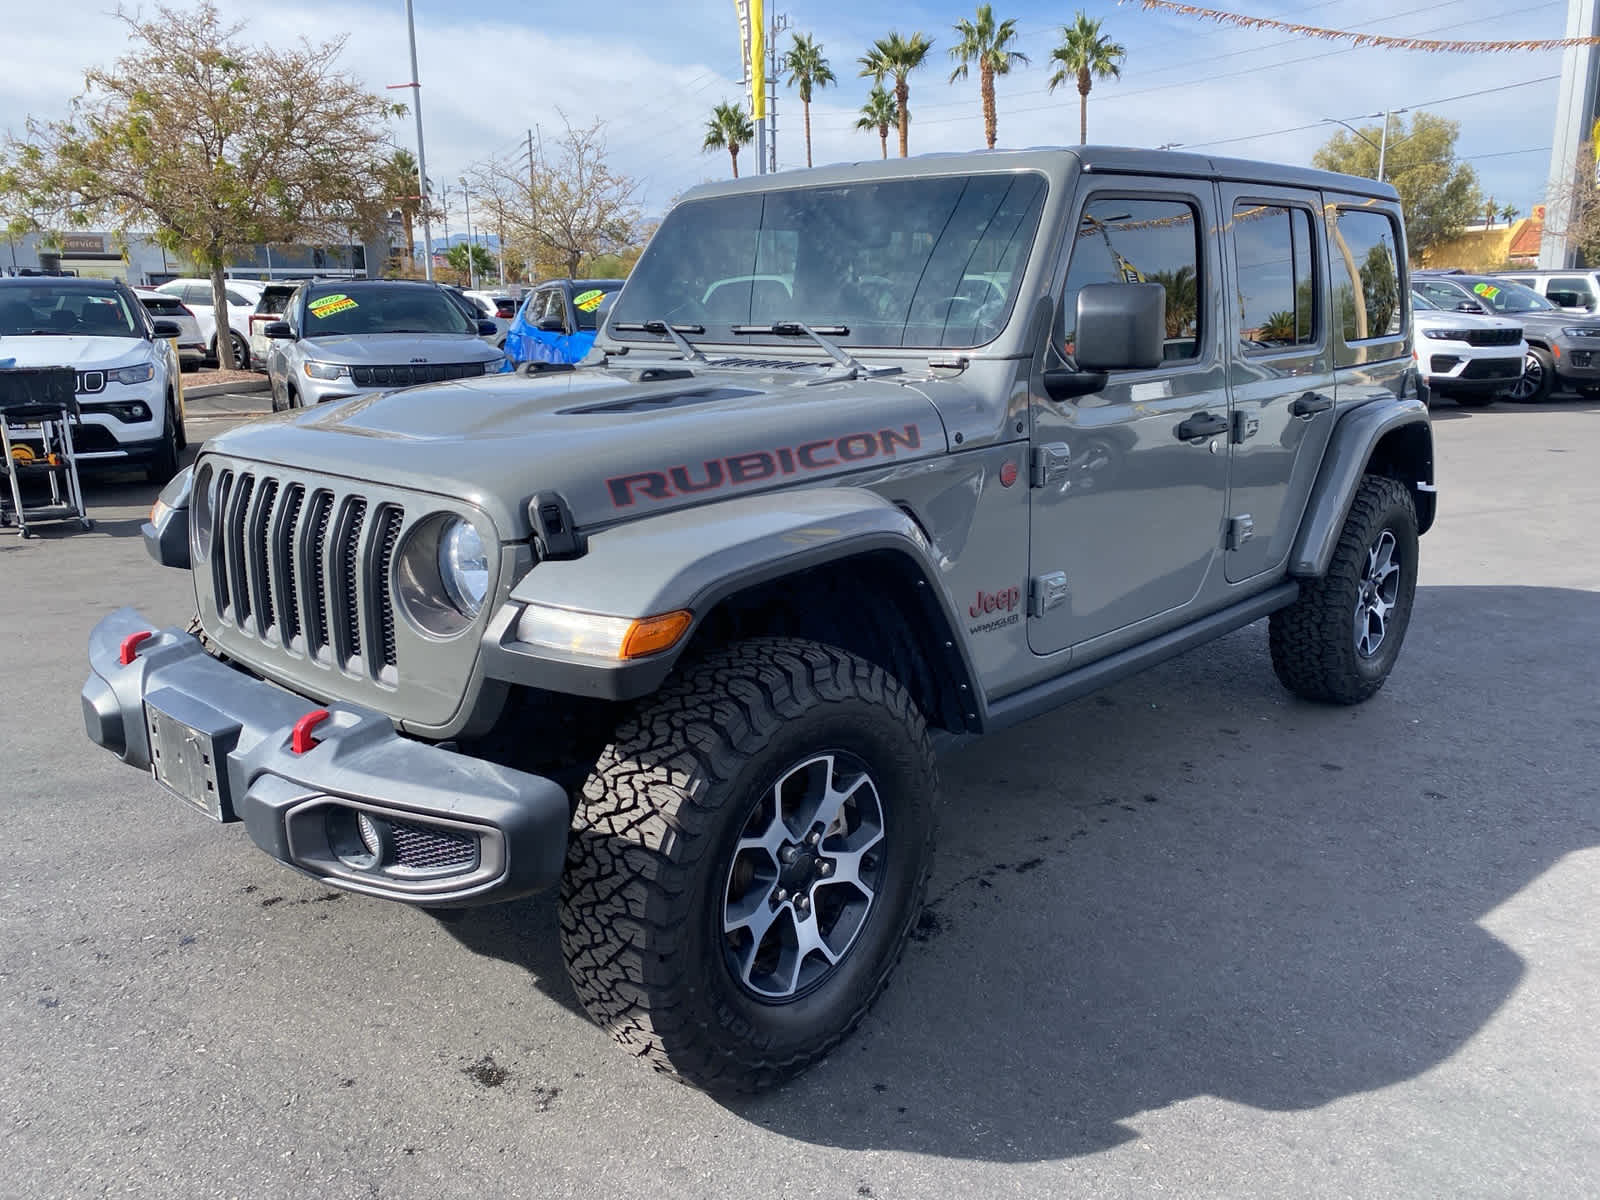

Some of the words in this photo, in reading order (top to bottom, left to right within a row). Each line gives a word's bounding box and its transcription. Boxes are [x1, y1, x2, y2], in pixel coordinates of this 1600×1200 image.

[605, 424, 921, 508] RUBICON
[968, 585, 1019, 618] Jeep
[969, 614, 1018, 634] WRANGLER
